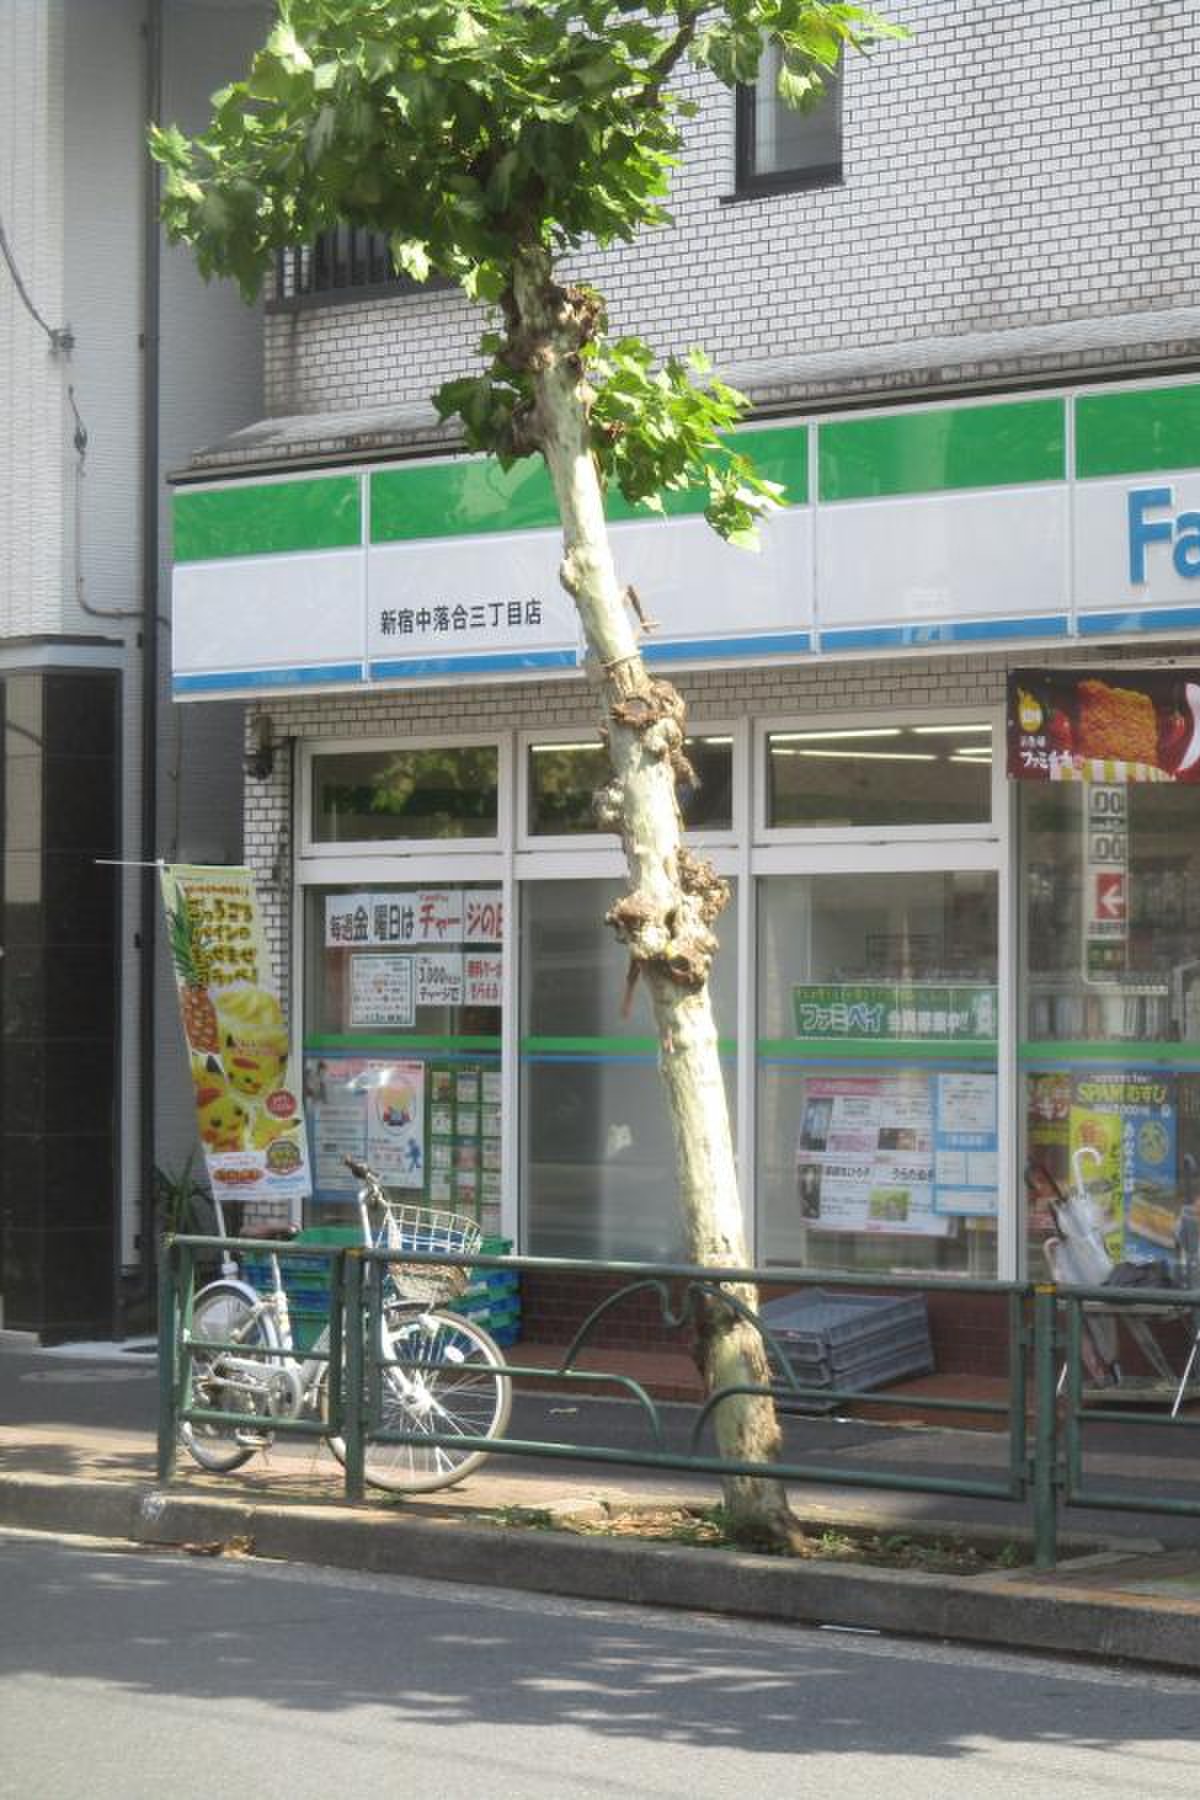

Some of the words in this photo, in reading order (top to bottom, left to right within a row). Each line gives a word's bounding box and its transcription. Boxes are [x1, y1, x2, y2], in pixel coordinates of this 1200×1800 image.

[381, 598, 542, 636] 新宿中落合三丁目店
